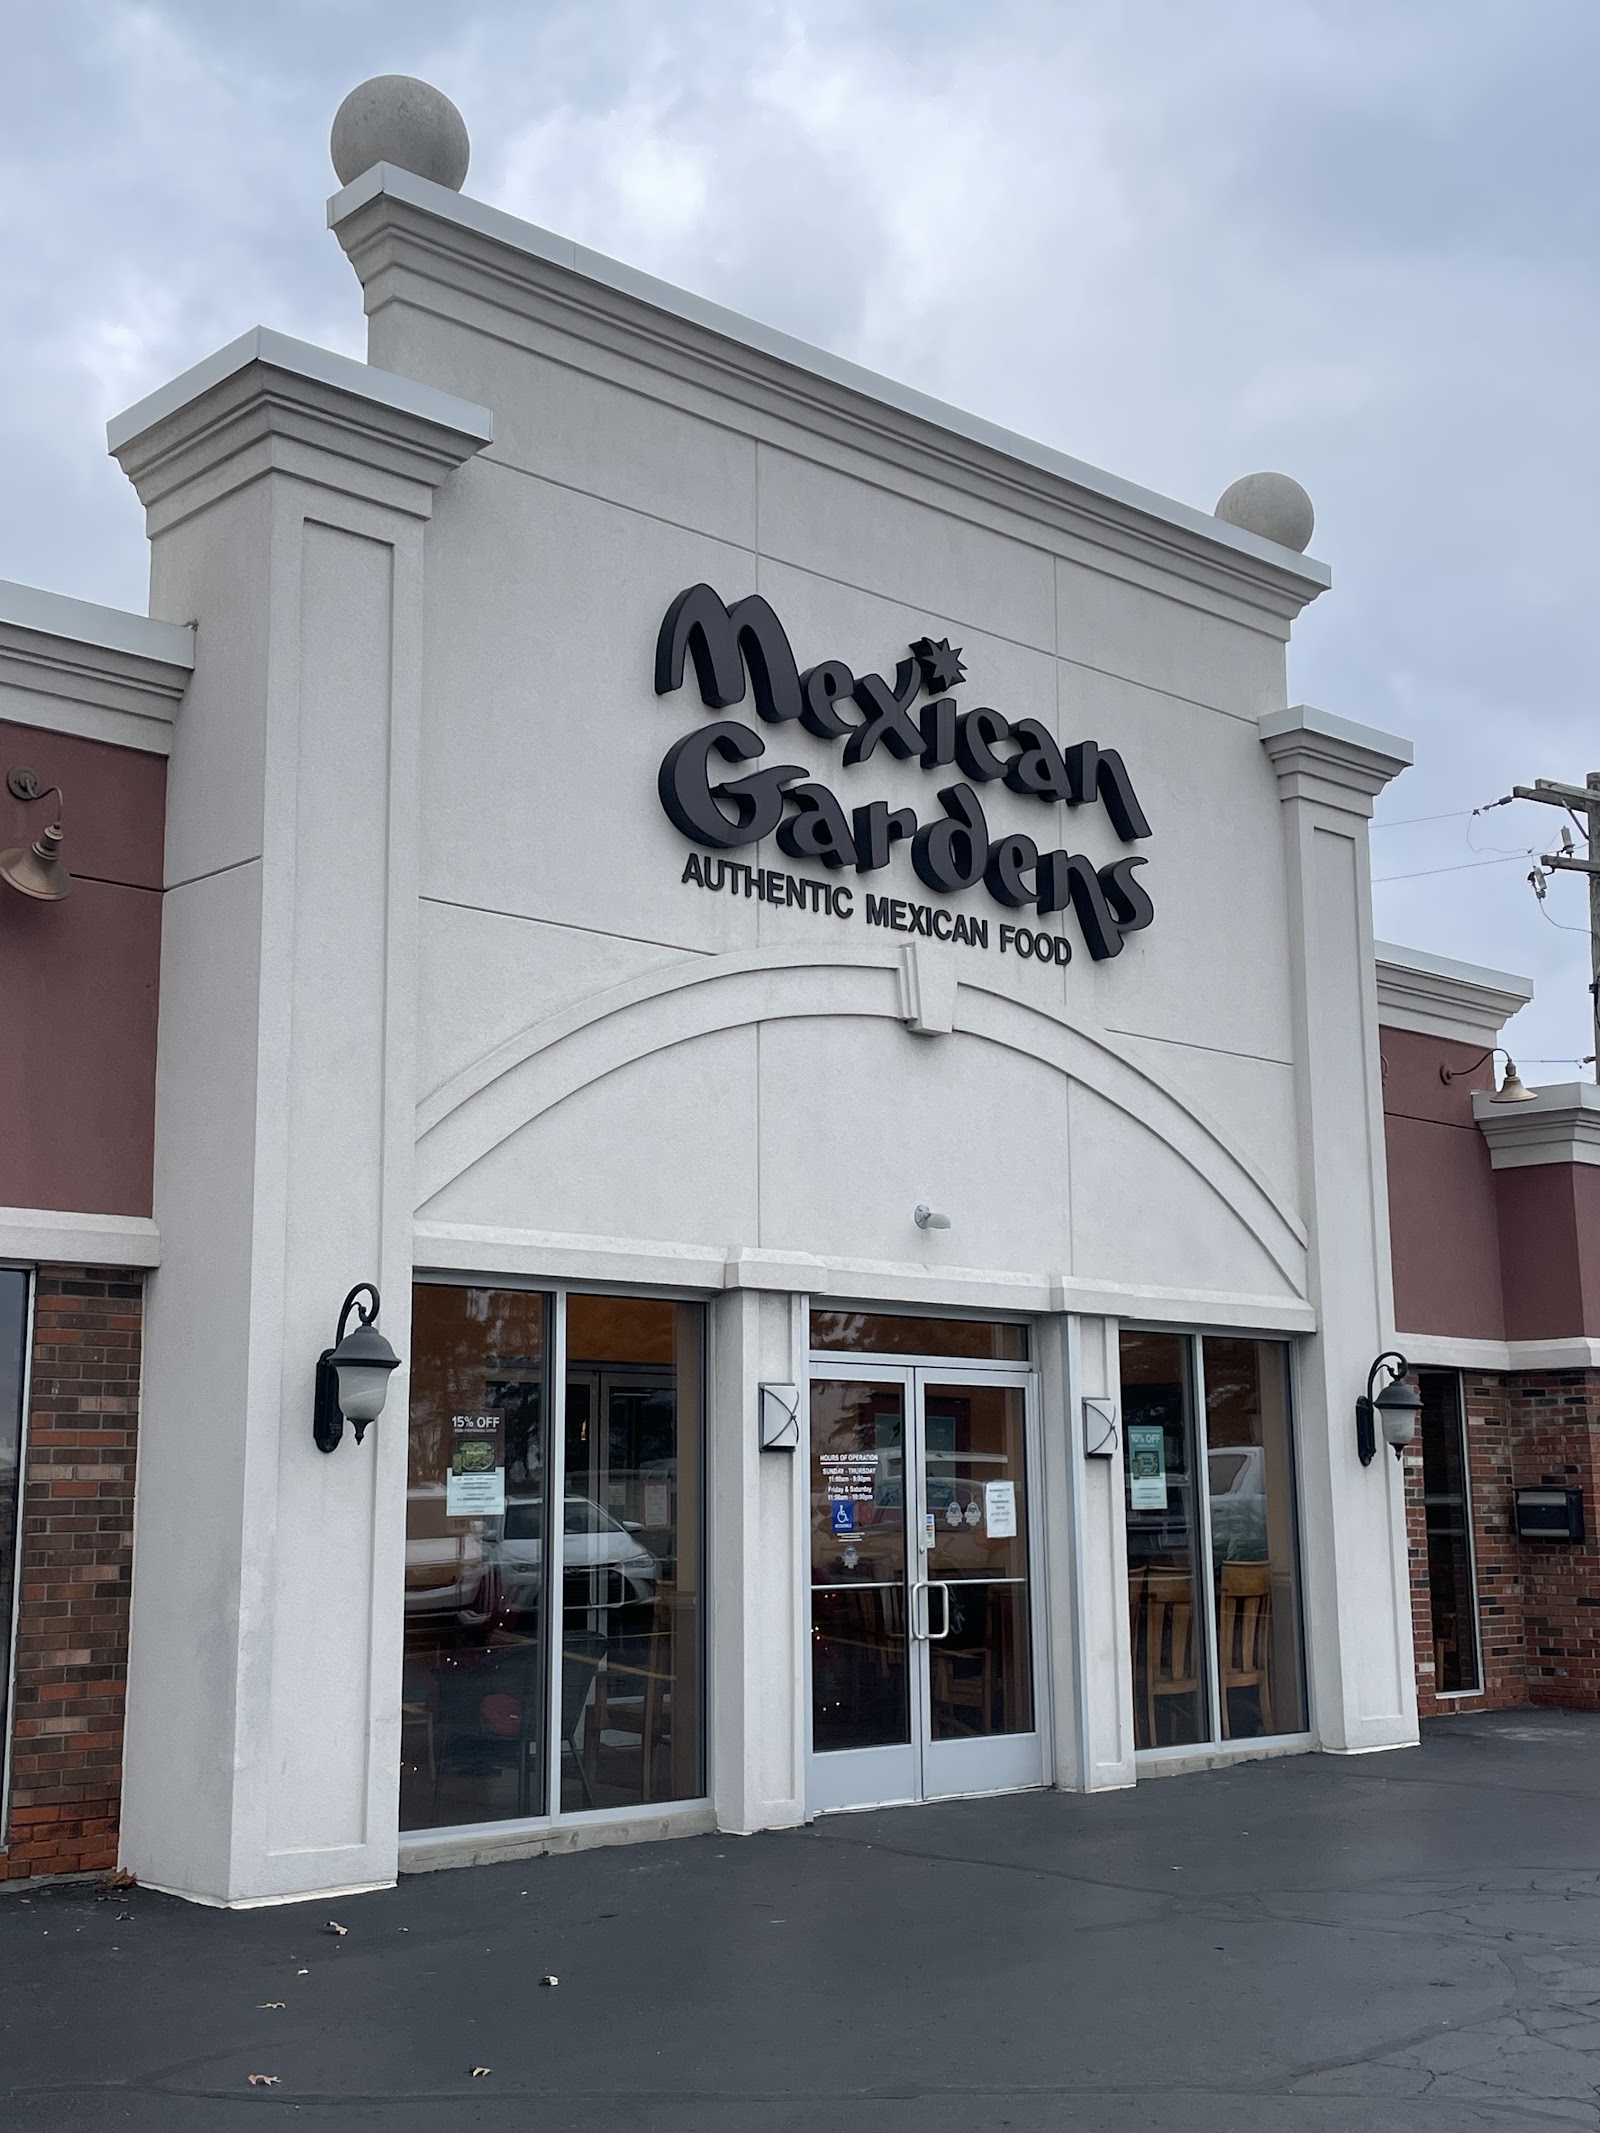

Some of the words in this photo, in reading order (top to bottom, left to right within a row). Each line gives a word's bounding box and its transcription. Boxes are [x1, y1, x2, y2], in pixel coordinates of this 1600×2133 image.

[655, 583, 1152, 842] Mexican
[658, 721, 1154, 961] Gardens
[682, 852, 854, 920] AUTHENTIC
[866, 893, 989, 949] MEXICAN
[999, 923, 1073, 966] FOOD
[451, 1415, 474, 1428] 15%
[476, 1416, 500, 1428] OFF
[1130, 1433, 1145, 1444] 10%
[1145, 1434, 1161, 1444] OFF
[848, 1467, 876, 1475] THURSDAY
[828, 1486, 844, 1494] Friday
[849, 1485, 873, 1494] Saturday
